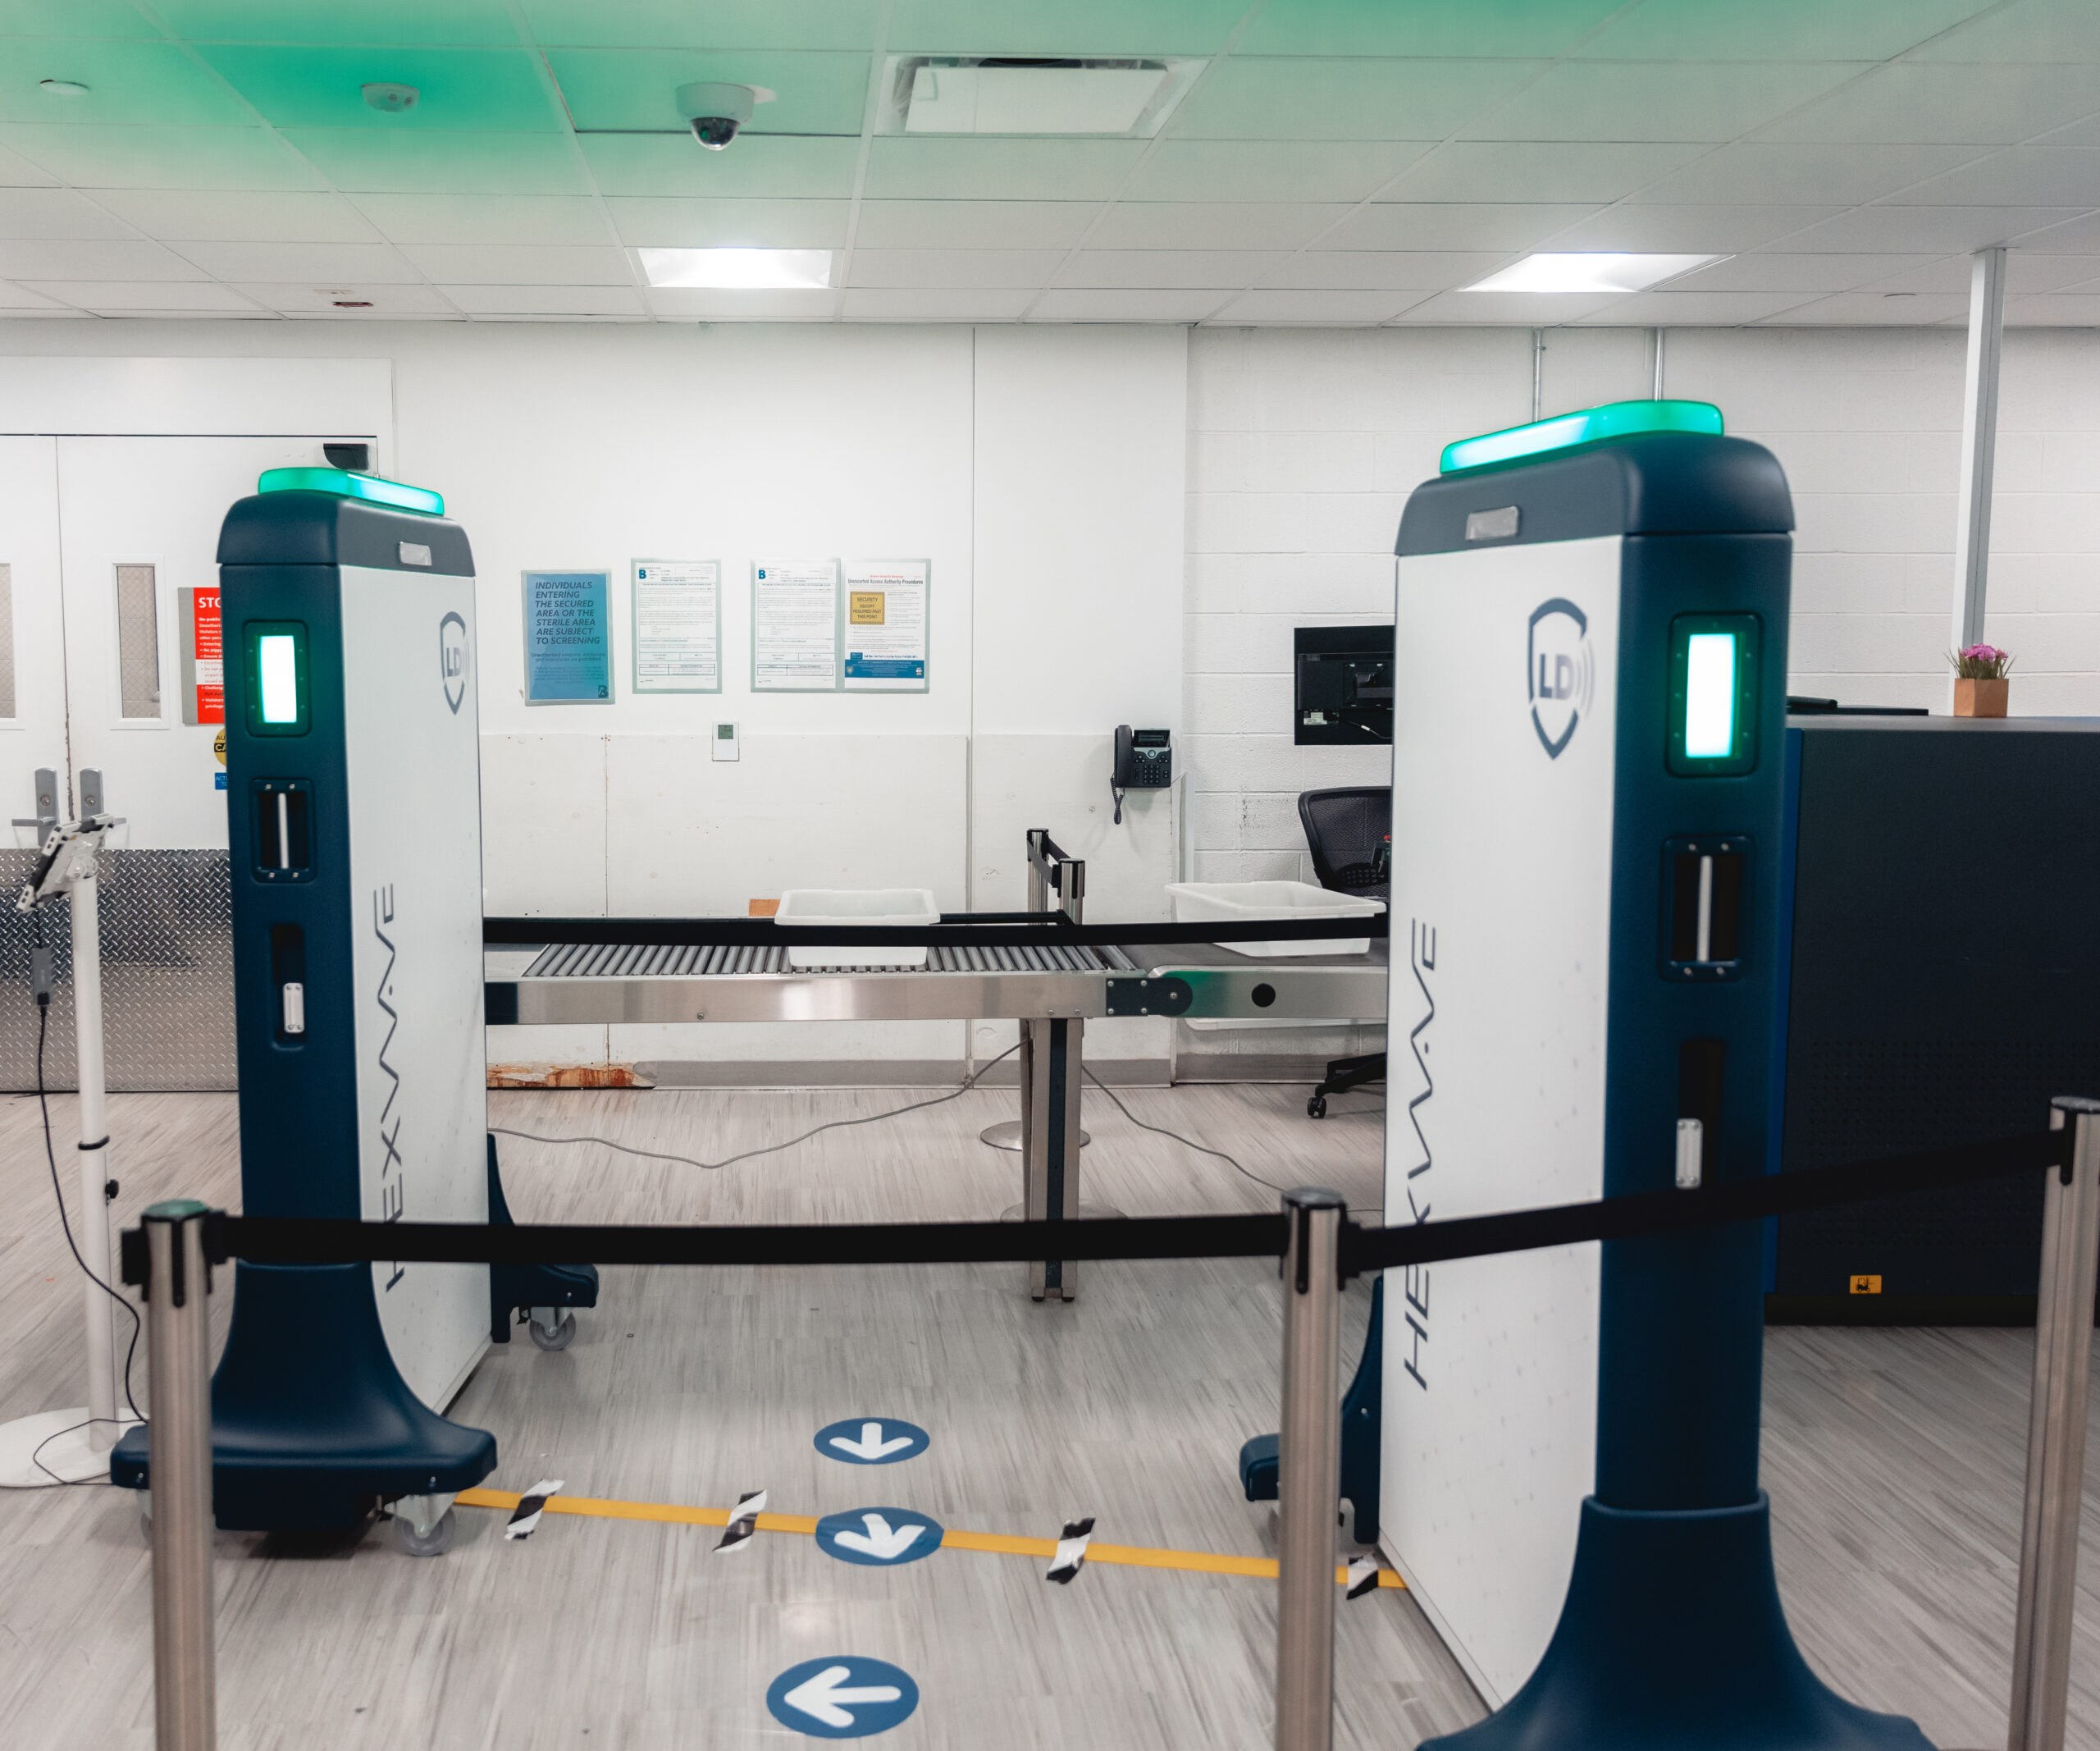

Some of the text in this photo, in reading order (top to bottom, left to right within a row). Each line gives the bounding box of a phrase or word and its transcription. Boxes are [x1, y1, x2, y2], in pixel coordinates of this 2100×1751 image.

[562, 609, 574, 617] OR
[536, 628, 554, 636] ARE
[550, 637, 600, 645] SCREENING
[446, 647, 462, 678] LD
[1538, 653, 1575, 700] LD
